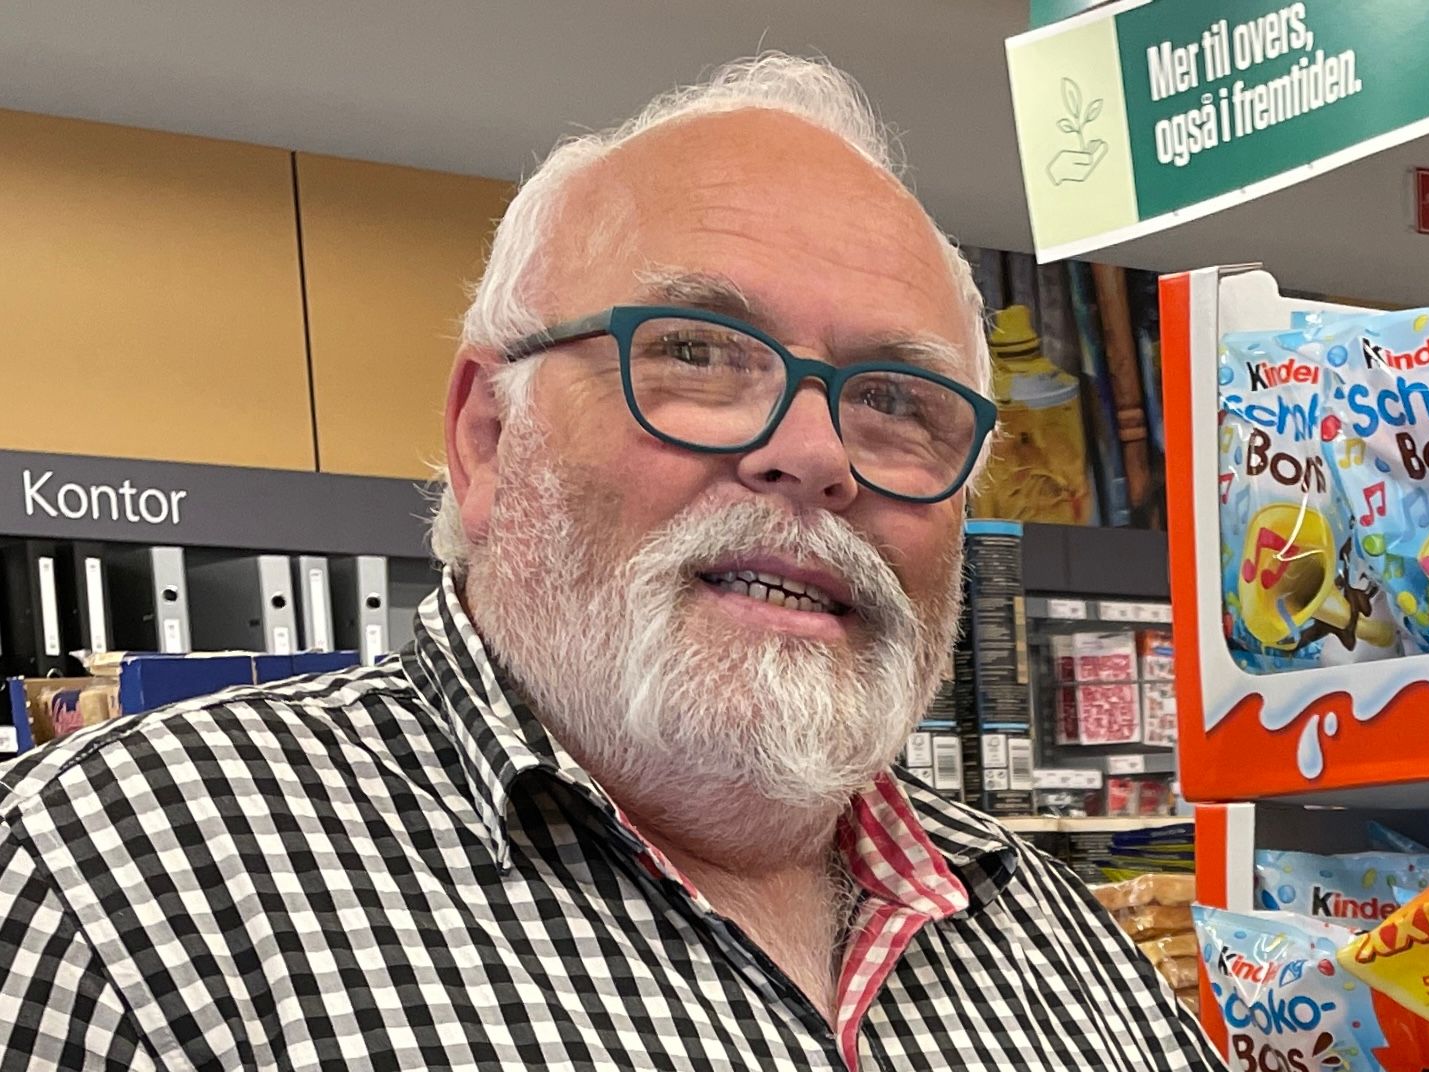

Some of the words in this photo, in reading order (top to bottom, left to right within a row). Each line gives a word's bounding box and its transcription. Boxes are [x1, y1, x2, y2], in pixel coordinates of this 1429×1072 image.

[1147, 39, 1199, 101] Mer
[1202, 28, 1231, 83] til
[1234, 2, 1314, 70] overs,
[1155, 94, 1219, 167] også
[1221, 89, 1232, 142] i
[1233, 49, 1363, 135] fremtiden.
[22, 470, 187, 524] Kontor
[1312, 886, 1398, 920] Kinde
